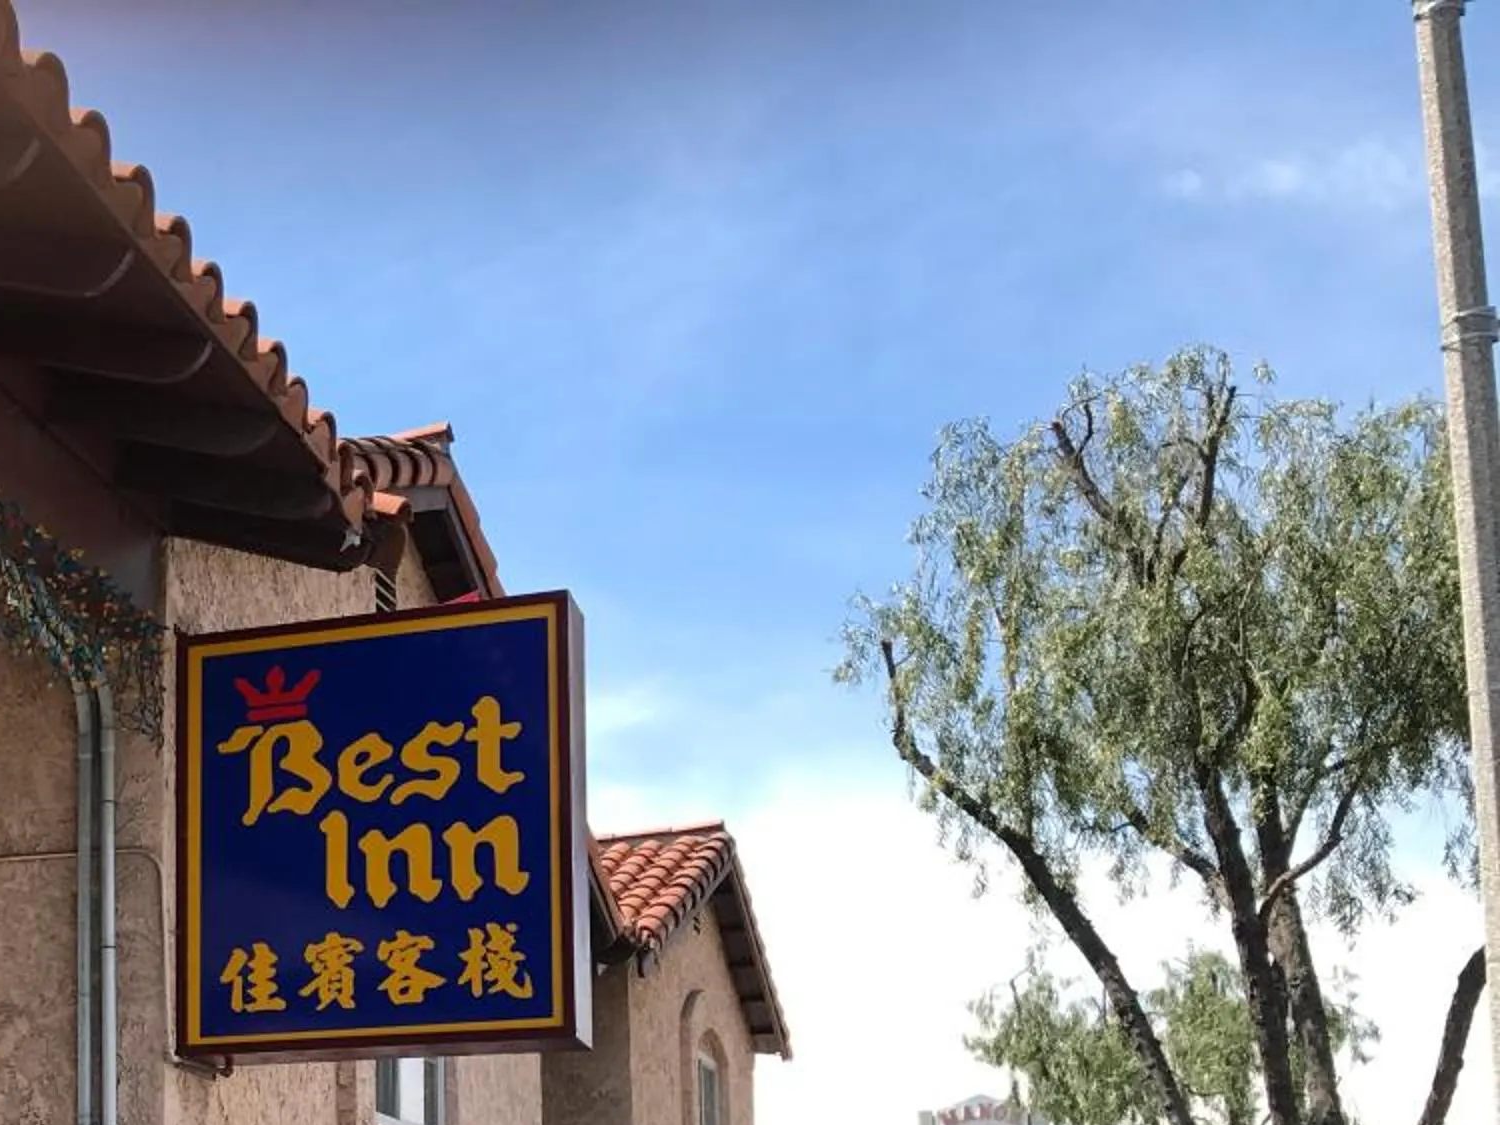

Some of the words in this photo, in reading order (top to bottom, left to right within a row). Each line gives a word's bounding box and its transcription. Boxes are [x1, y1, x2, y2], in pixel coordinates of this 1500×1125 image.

[217, 696, 525, 827] Best
[319, 810, 530, 909] Inn
[219, 922, 534, 1013] 佳賓客棧
